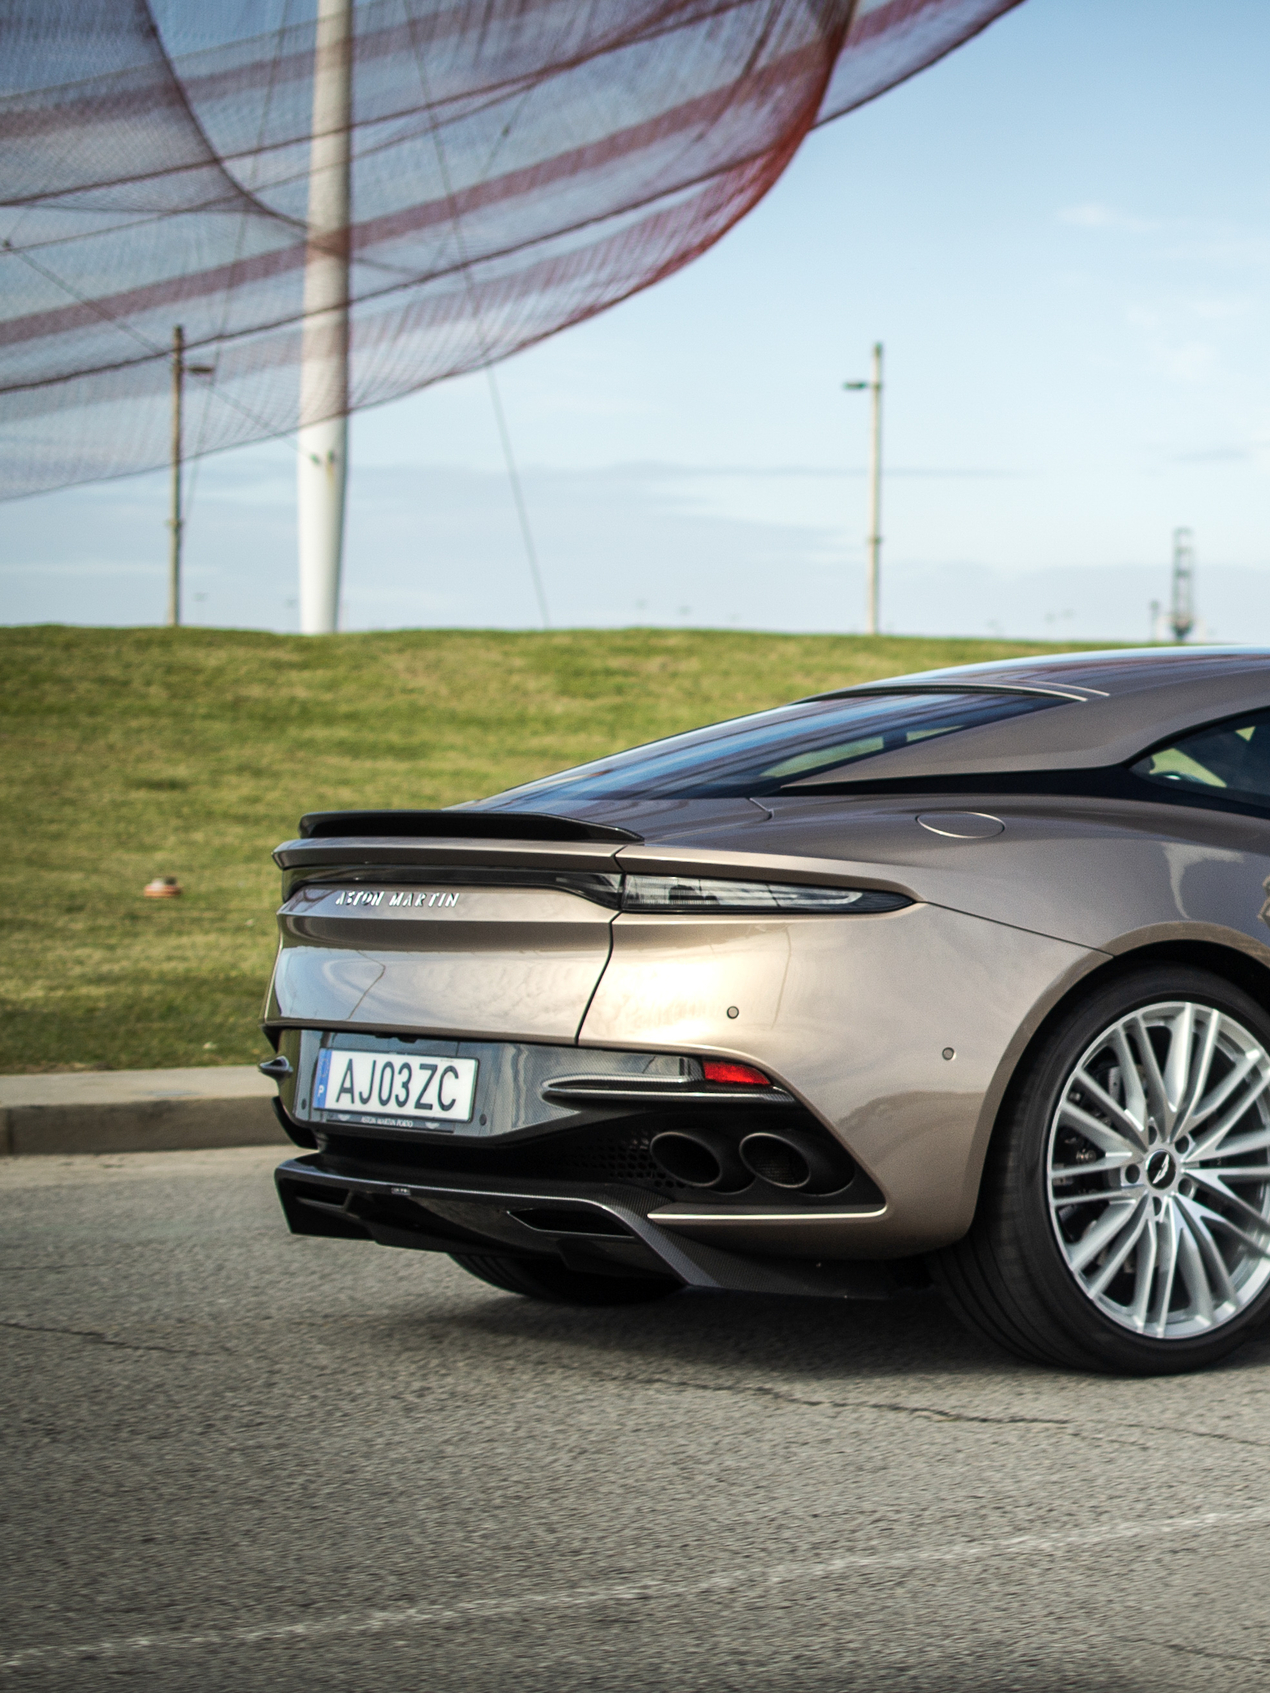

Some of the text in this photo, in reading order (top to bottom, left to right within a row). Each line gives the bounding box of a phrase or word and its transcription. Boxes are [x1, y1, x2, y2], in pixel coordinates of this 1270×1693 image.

[335, 891, 460, 908] ASTON MARTIN
[335, 1057, 460, 1112] AJ03ZC
